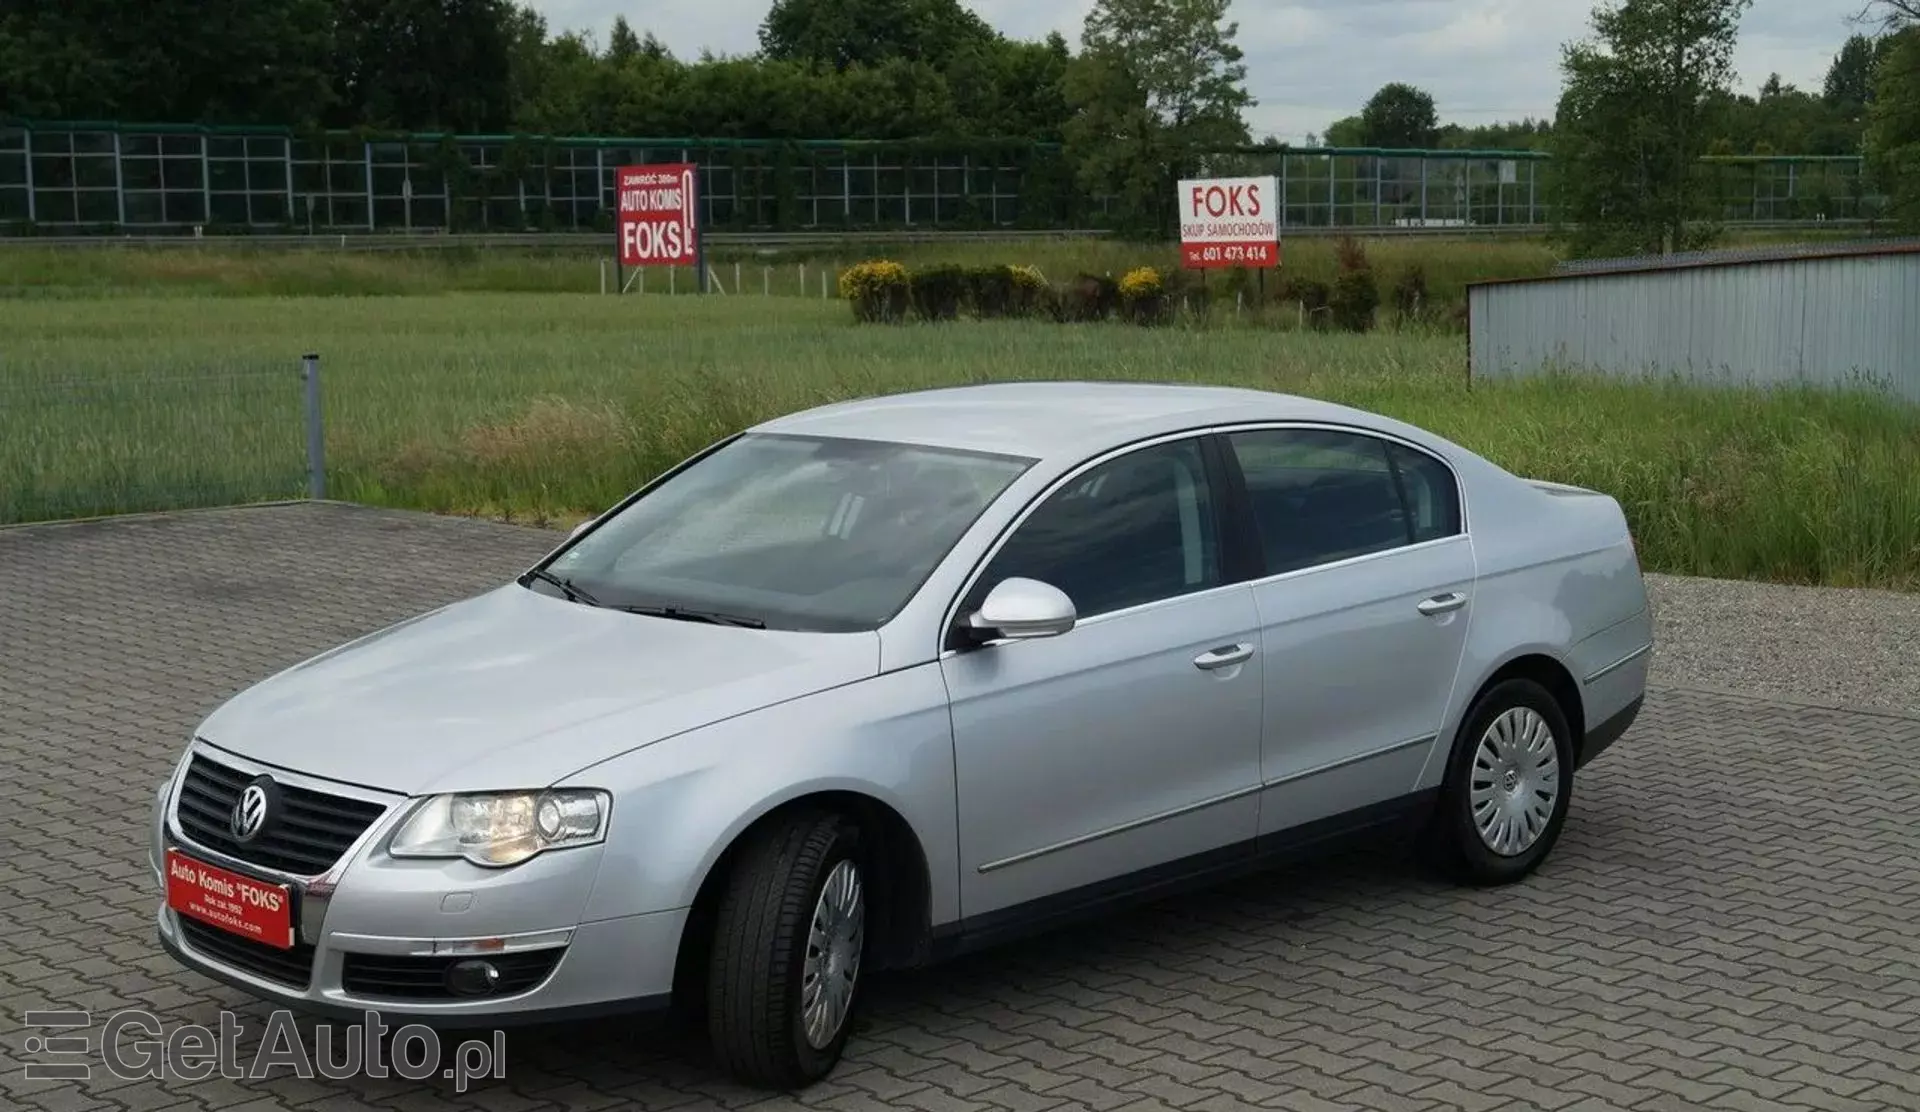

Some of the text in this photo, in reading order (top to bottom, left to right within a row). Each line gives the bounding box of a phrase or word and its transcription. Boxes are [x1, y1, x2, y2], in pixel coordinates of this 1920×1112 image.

[621, 188, 682, 211] AUTO KOMIS
[1192, 184, 1260, 217] FOKS
[623, 221, 681, 258] FOKS
[1182, 220, 1274, 237] SKUP SAMOCHODÓW
[1203, 247, 1221, 260] 601
[1224, 246, 1244, 260] 473
[1246, 246, 1266, 260] 414
[171, 859, 196, 884] Auto
[198, 870, 234, 898] Komis
[204, 893, 216, 906] Rok
[189, 901, 262, 934] www.autofoks.com
